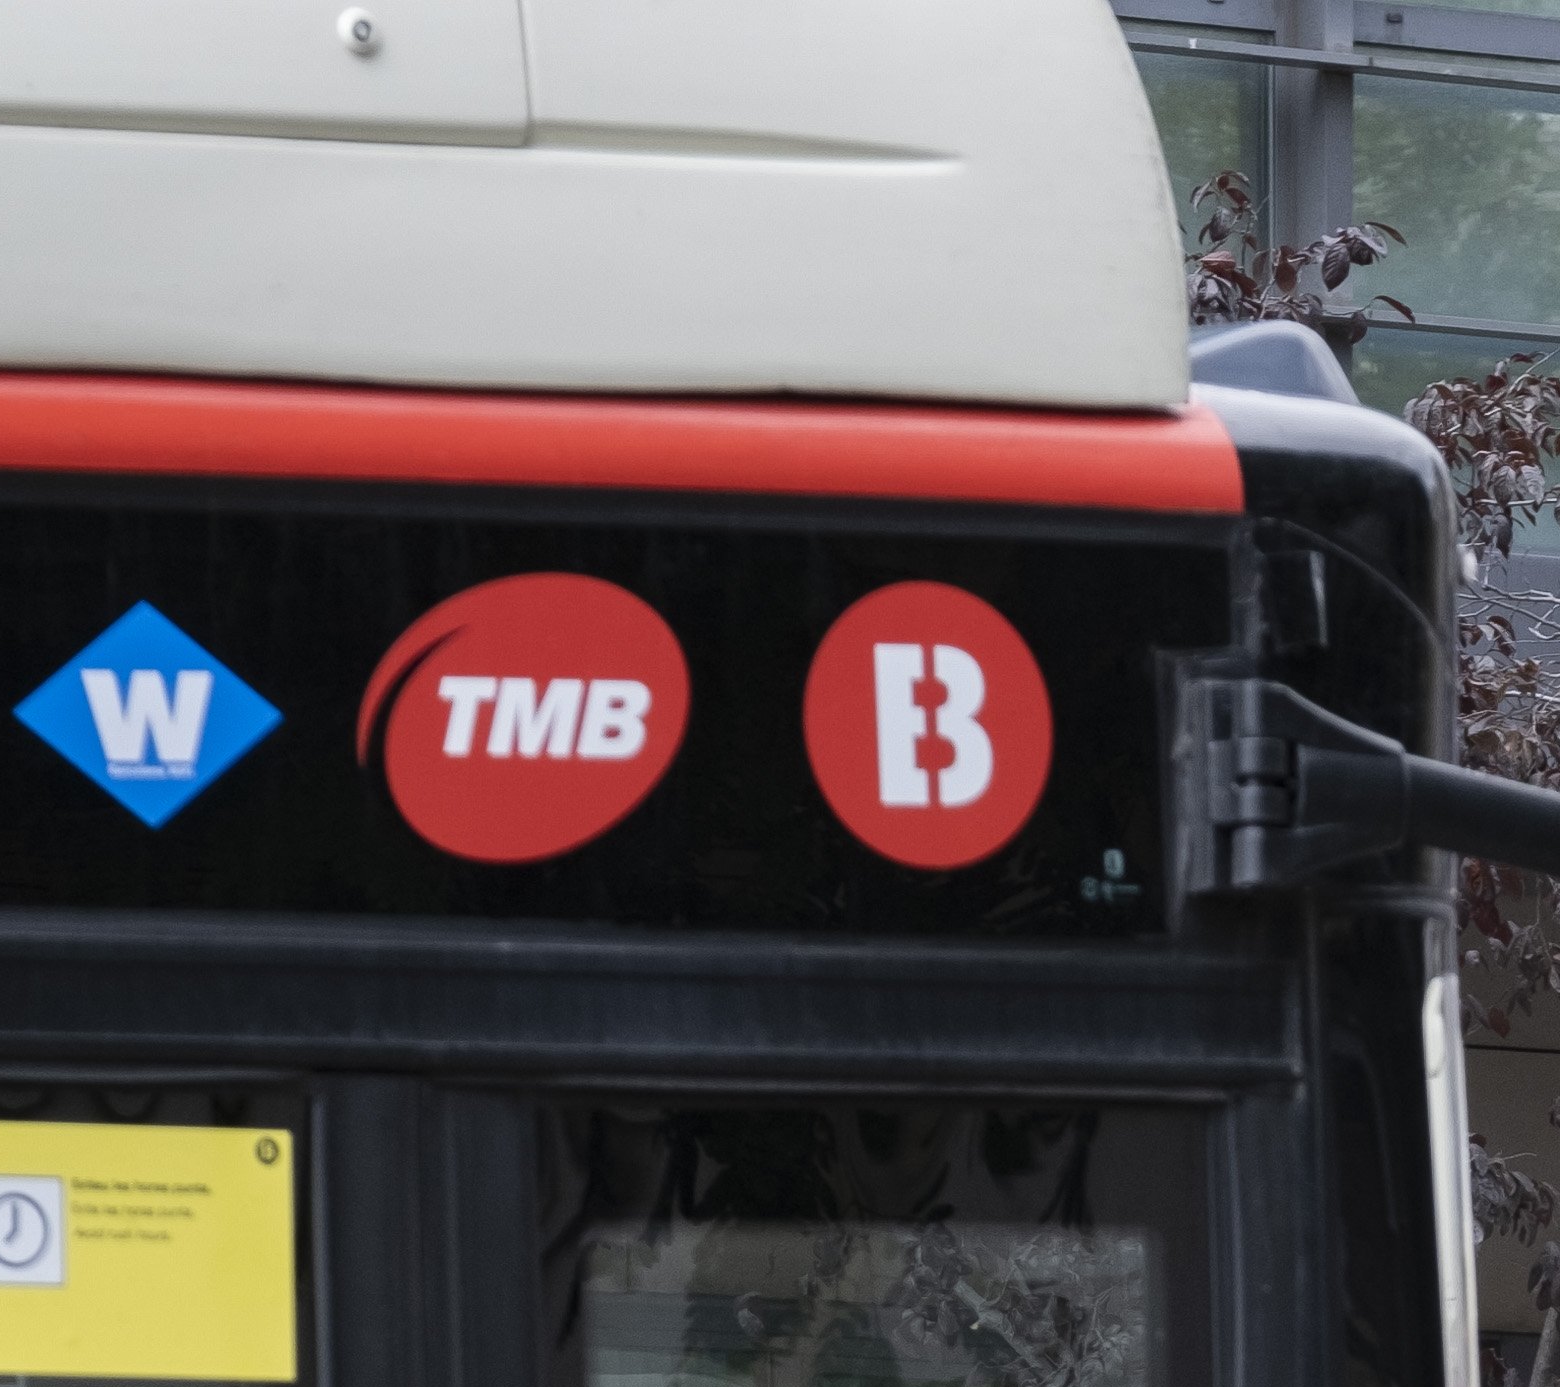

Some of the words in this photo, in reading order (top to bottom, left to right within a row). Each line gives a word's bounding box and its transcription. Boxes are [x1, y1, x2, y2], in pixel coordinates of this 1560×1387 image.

[79, 667, 215, 761] W
[437, 676, 652, 759] TMB
[873, 643, 993, 807] B
